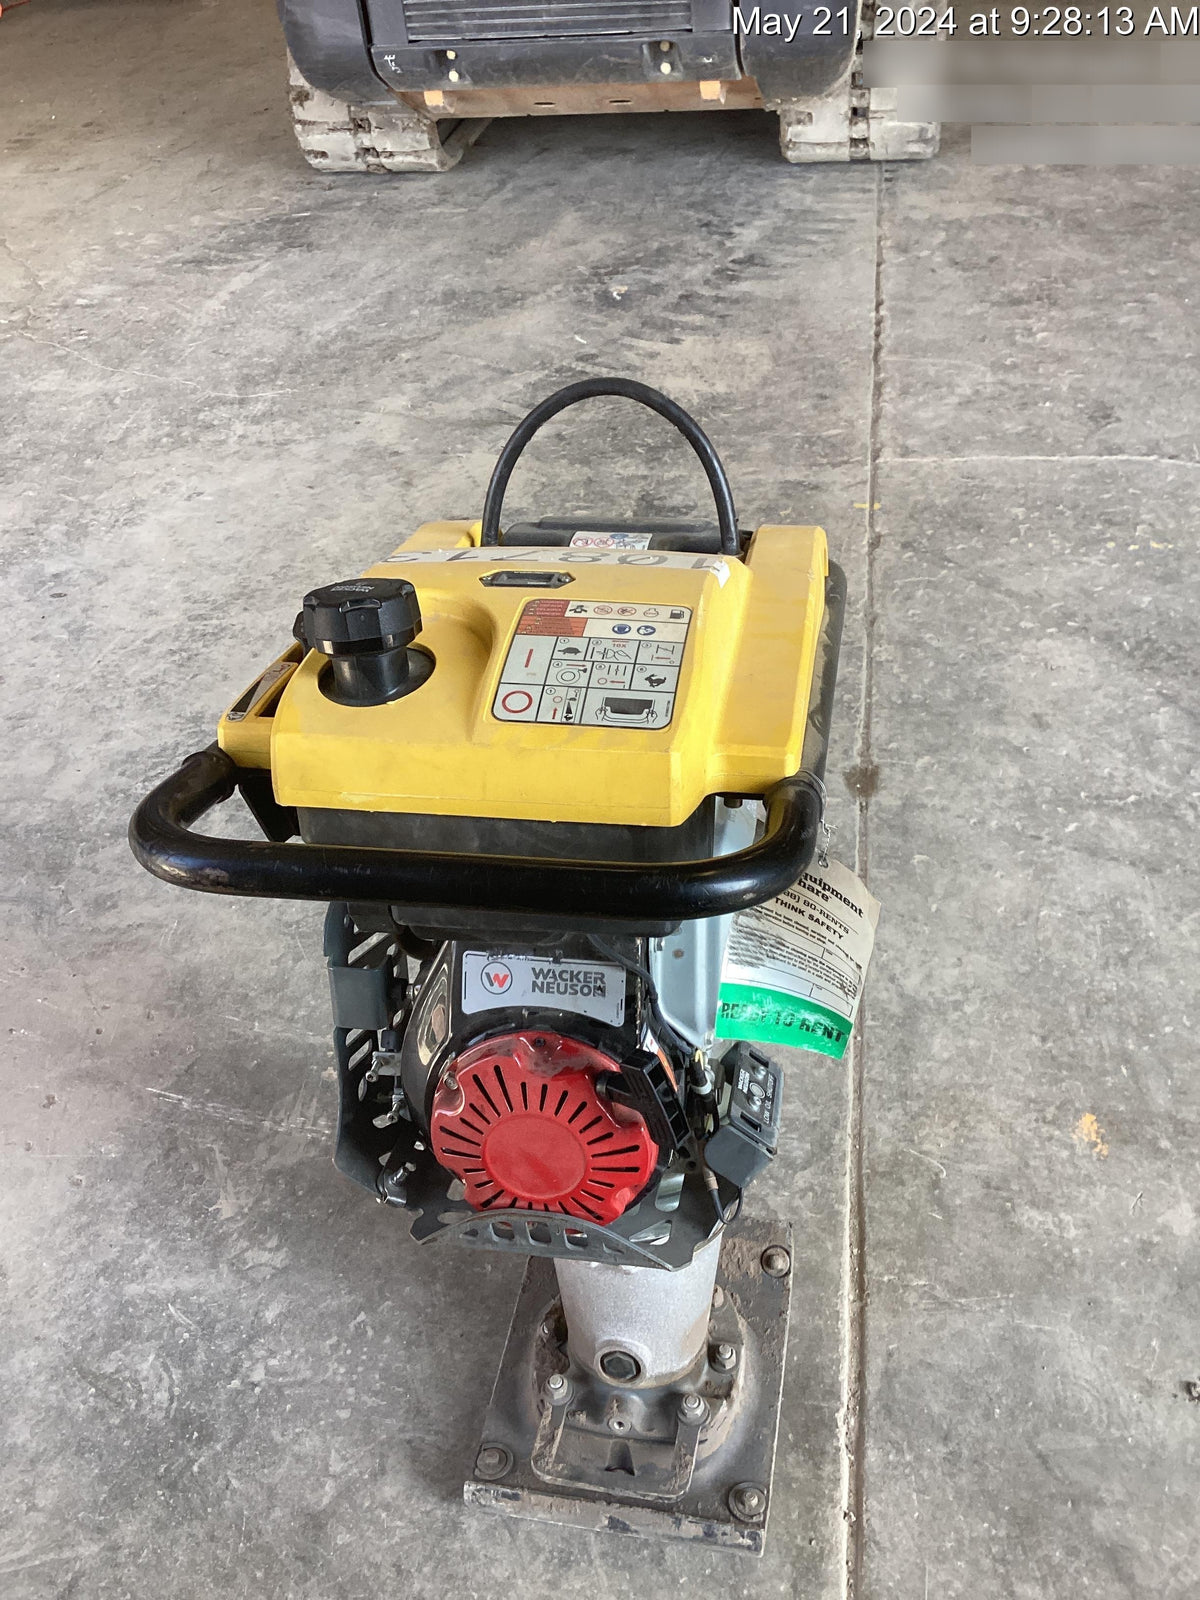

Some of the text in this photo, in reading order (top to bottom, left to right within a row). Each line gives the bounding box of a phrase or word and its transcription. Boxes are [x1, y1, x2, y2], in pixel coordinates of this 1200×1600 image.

[797, 878, 830, 903] hare
[802, 872, 864, 918] quipment
[775, 896, 806, 917] THINK
[808, 913, 844, 940] SAFETY
[531, 966, 607, 985] WACKER
[531, 980, 607, 999] NEUSON
